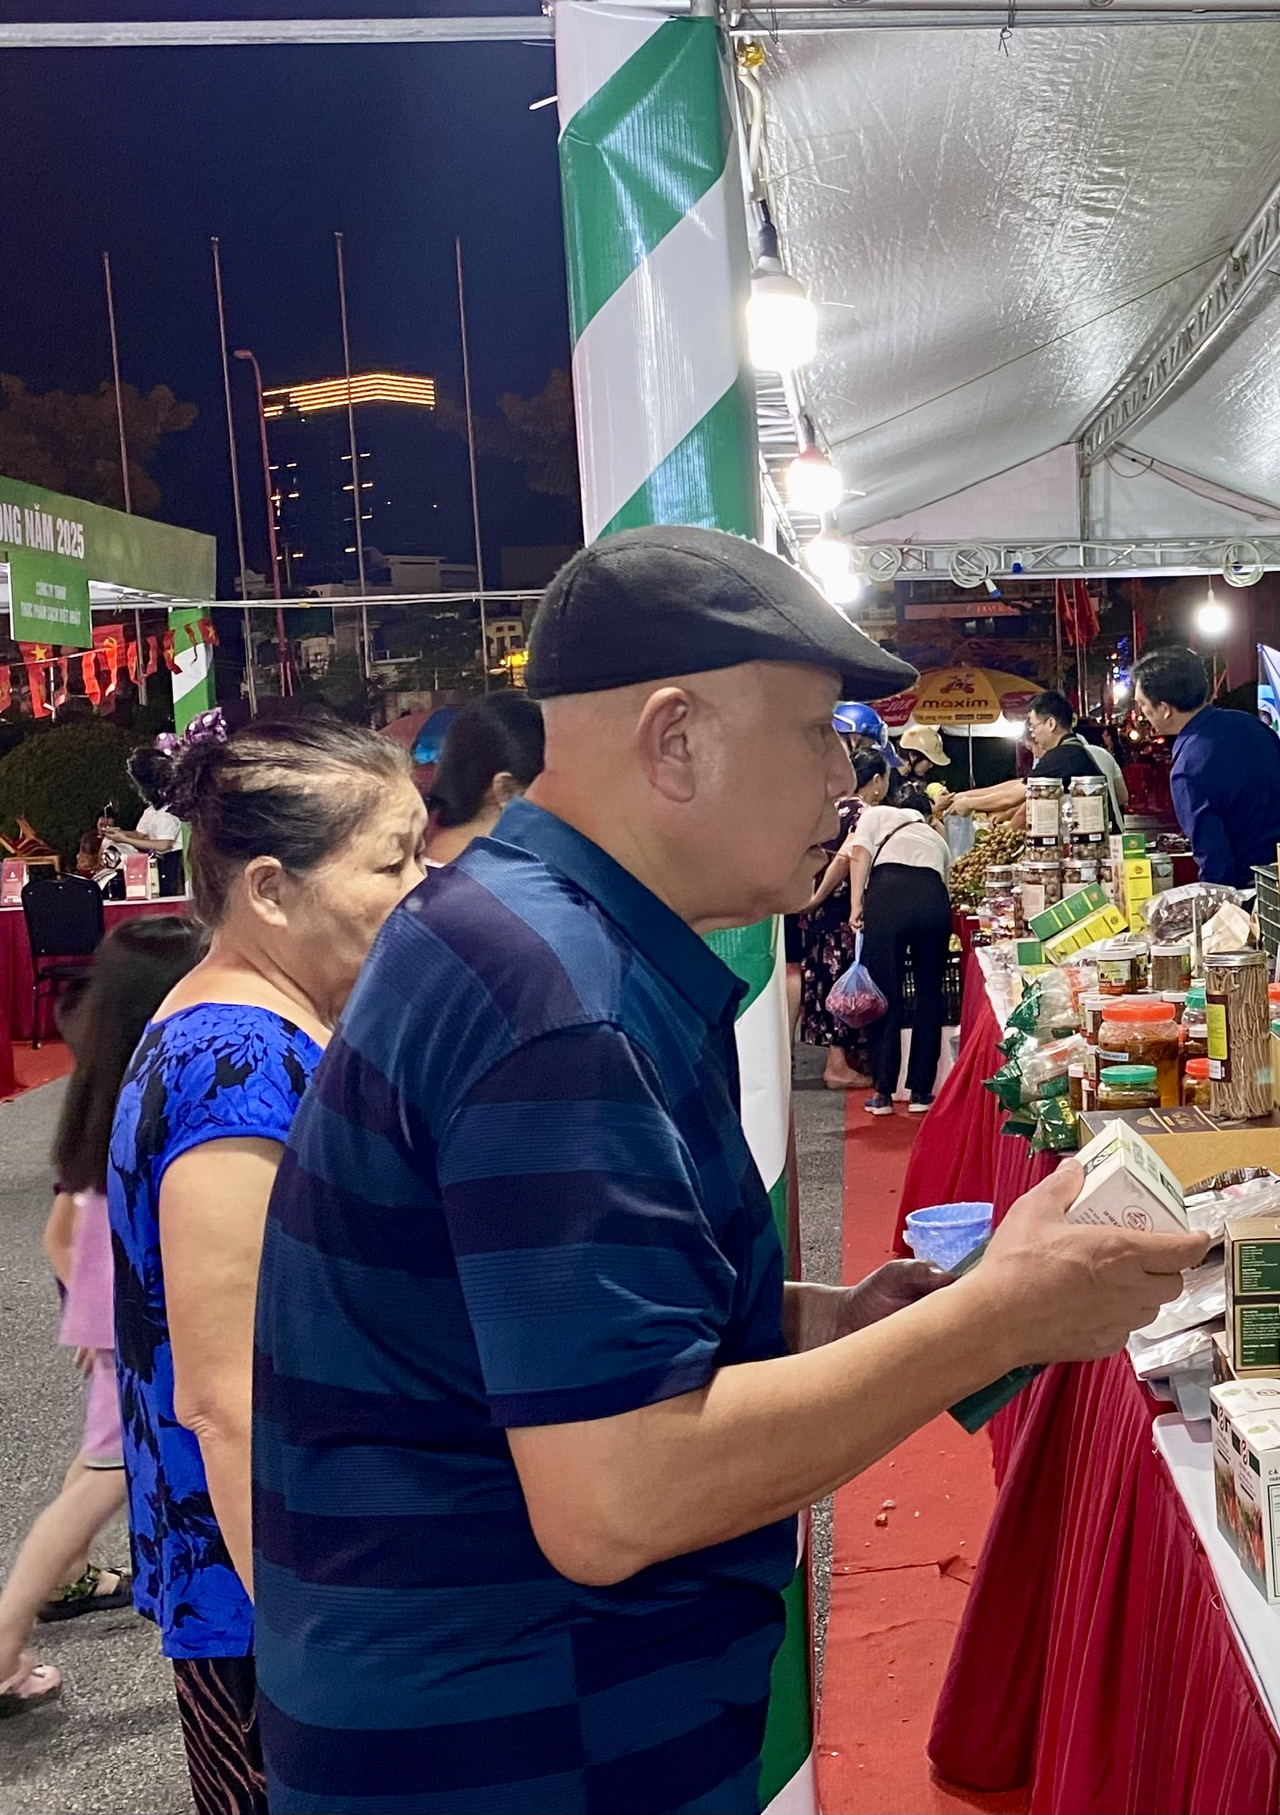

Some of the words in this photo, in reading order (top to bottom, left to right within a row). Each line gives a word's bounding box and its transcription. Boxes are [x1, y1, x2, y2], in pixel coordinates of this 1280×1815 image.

[24, 503, 54, 552] NĂM
[56, 517, 85, 559] 2025
[922, 698, 988, 708] maxim
